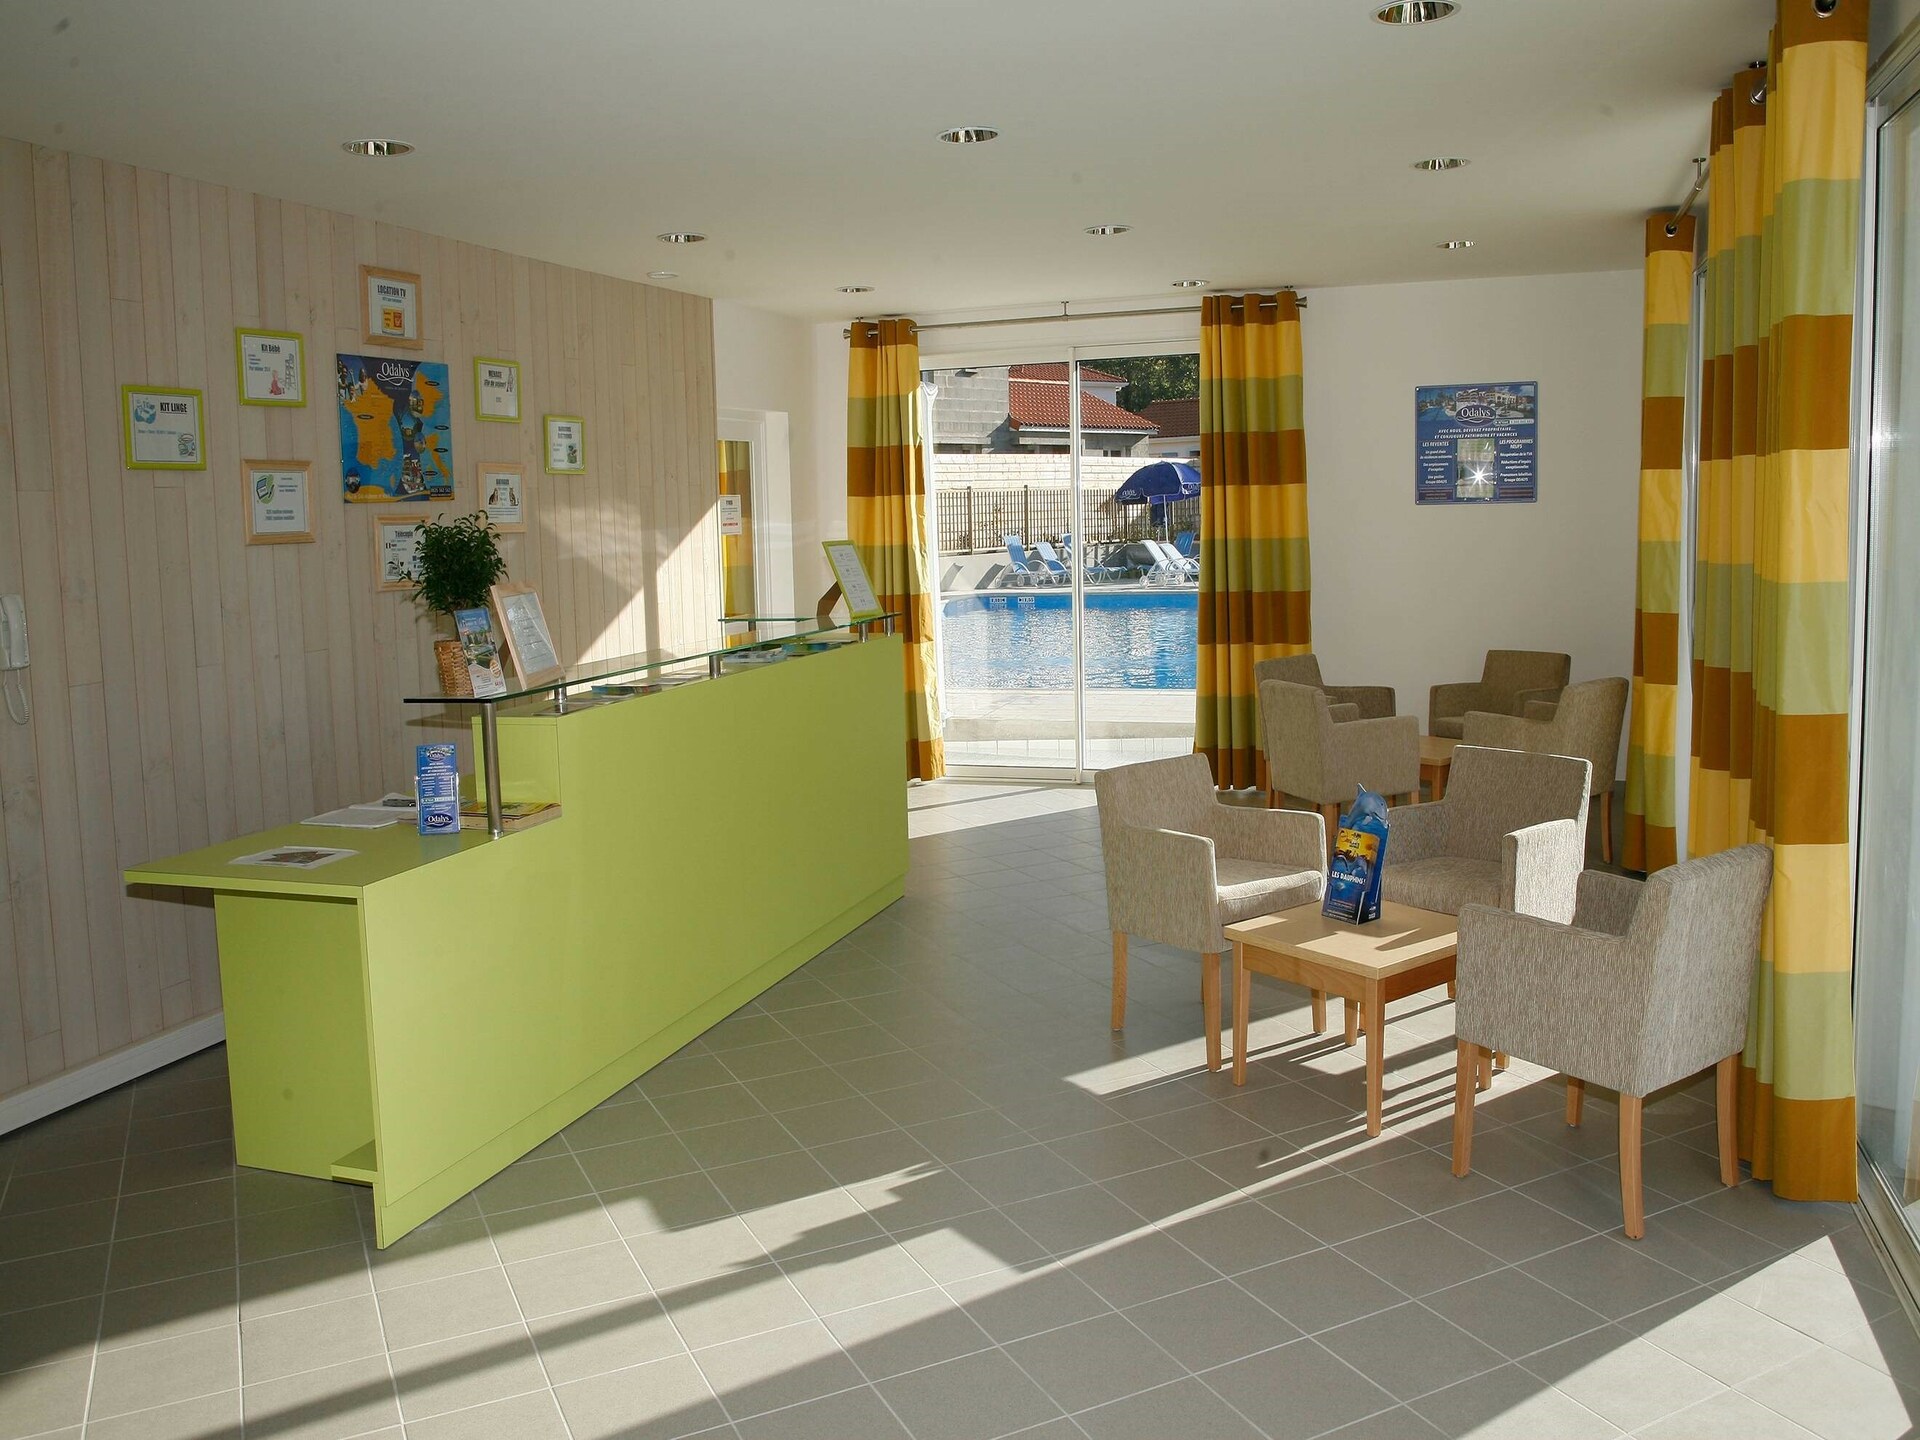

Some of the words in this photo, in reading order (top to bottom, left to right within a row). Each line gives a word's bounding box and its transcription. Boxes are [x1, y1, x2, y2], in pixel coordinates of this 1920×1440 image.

[377, 284, 399, 296] LOCATION
[400, 288, 407, 297] TV
[380, 361, 411, 379] Odalys
[160, 402, 170, 411] KIT
[170, 403, 187, 412] LINGE
[1460, 407, 1491, 420] Odalys
[427, 815, 450, 823] Odalys
[1331, 870, 1340, 878] LES
